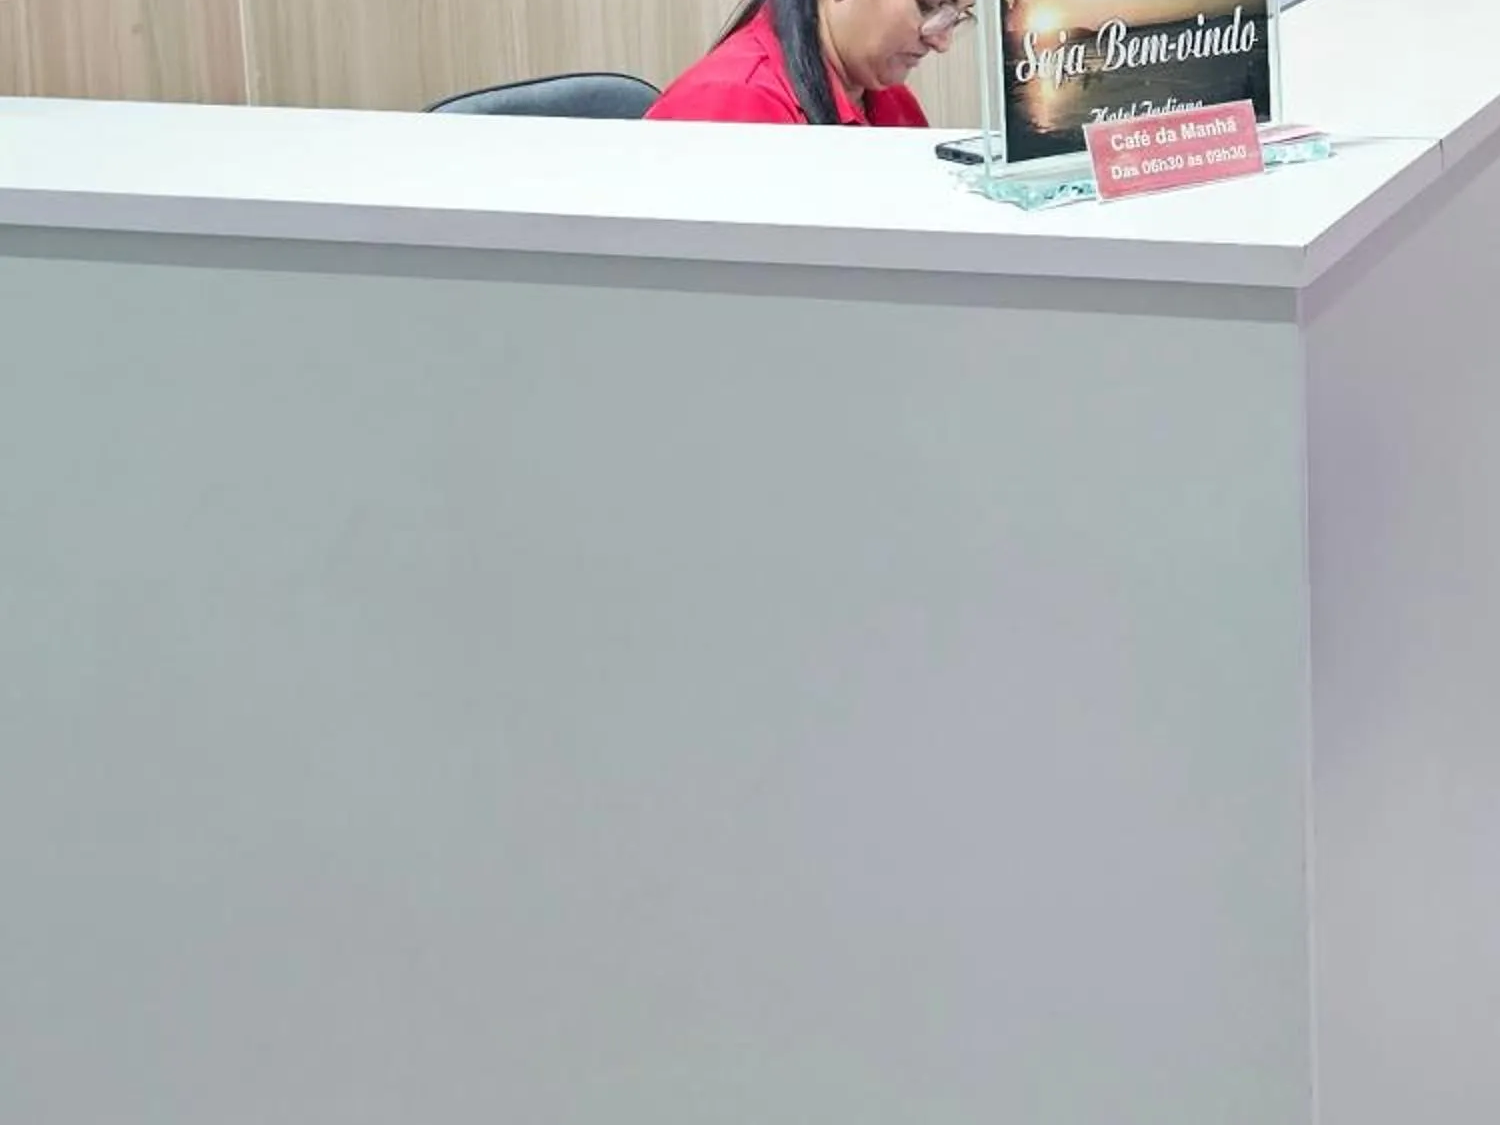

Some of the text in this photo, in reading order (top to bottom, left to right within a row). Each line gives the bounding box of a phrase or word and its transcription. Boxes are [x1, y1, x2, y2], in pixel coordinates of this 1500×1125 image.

[1015, 5, 1259, 89] Seja Bem-vindo
[1110, 116, 1238, 151] Café da Manhã
[1142, 155, 1185, 175] 06h30
[1205, 144, 1247, 165] 09h30
